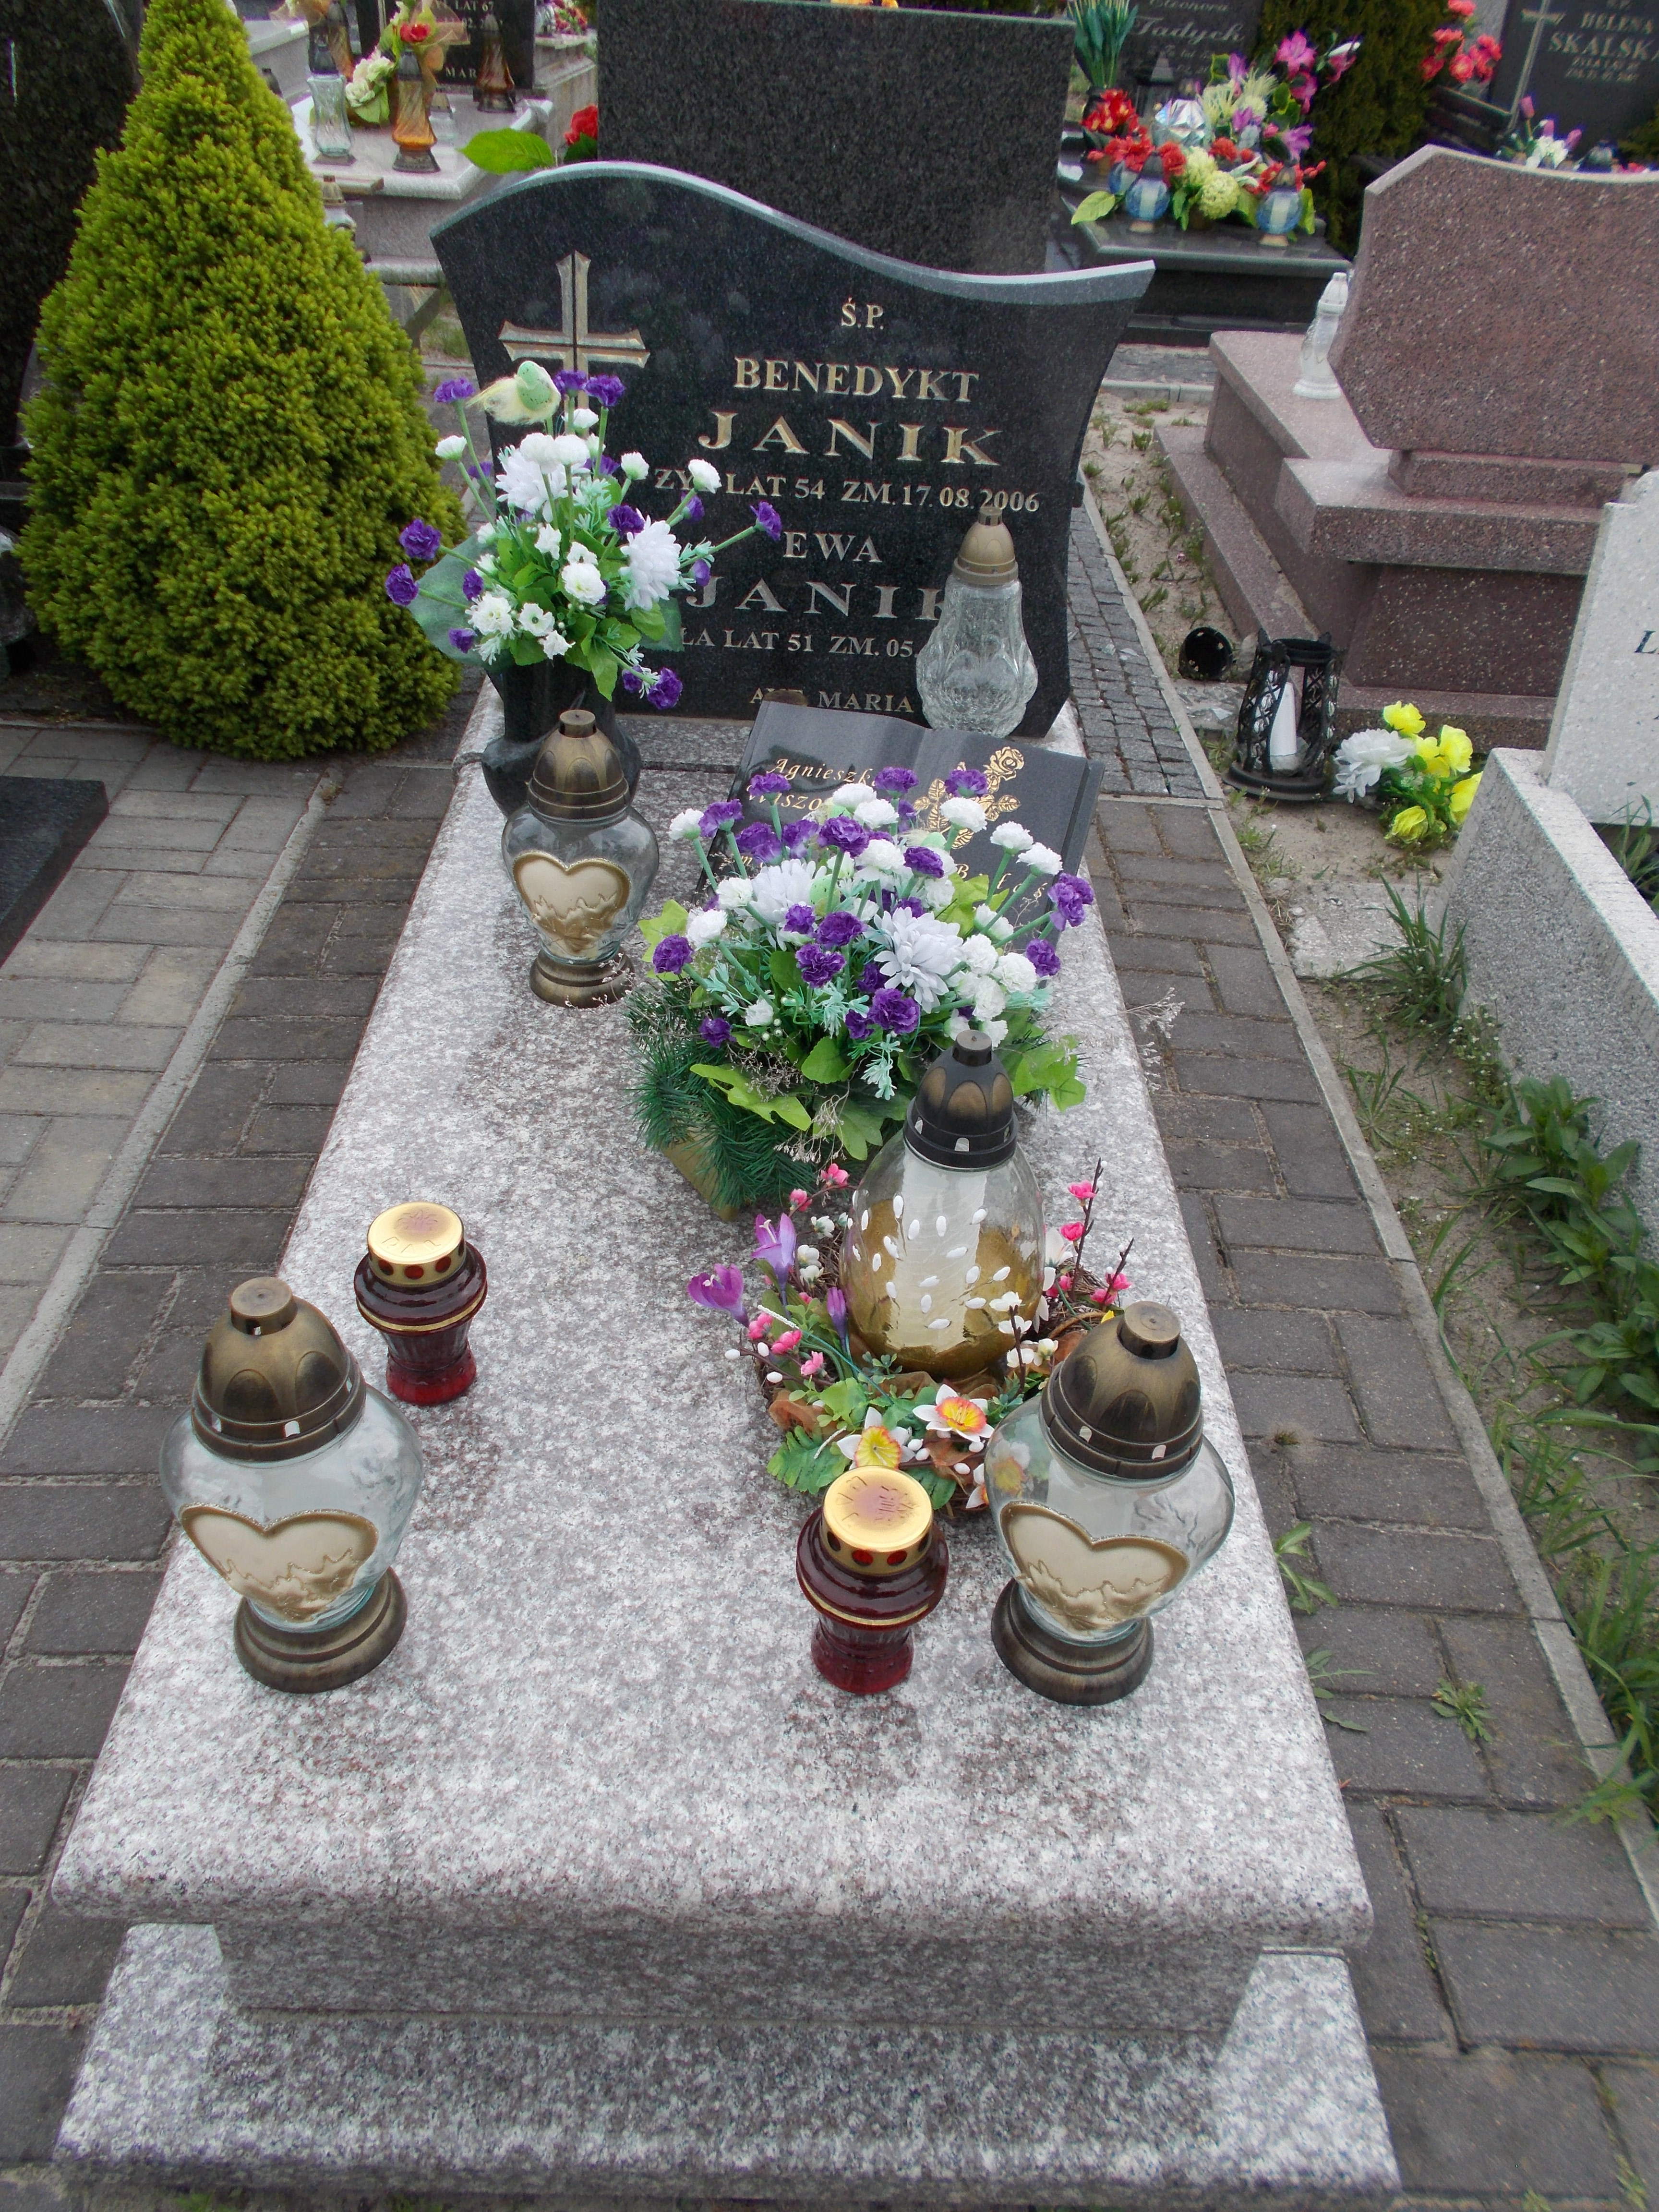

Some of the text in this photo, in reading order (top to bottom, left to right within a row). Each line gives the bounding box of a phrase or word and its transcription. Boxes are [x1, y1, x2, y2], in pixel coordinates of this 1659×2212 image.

[1547, 32, 1659, 61] SKALSK
[445, 66, 477, 79] MAR
[733, 356, 980, 402] BENEDYKT
[698, 410, 1003, 466] JANIK
[726, 472, 787, 497] LAT
[794, 477, 826, 499] 54
[782, 530, 883, 563] EWA
[722, 629, 780, 649] LAT
[787, 633, 814, 652] 51
[817, 690, 914, 712] MARIA
